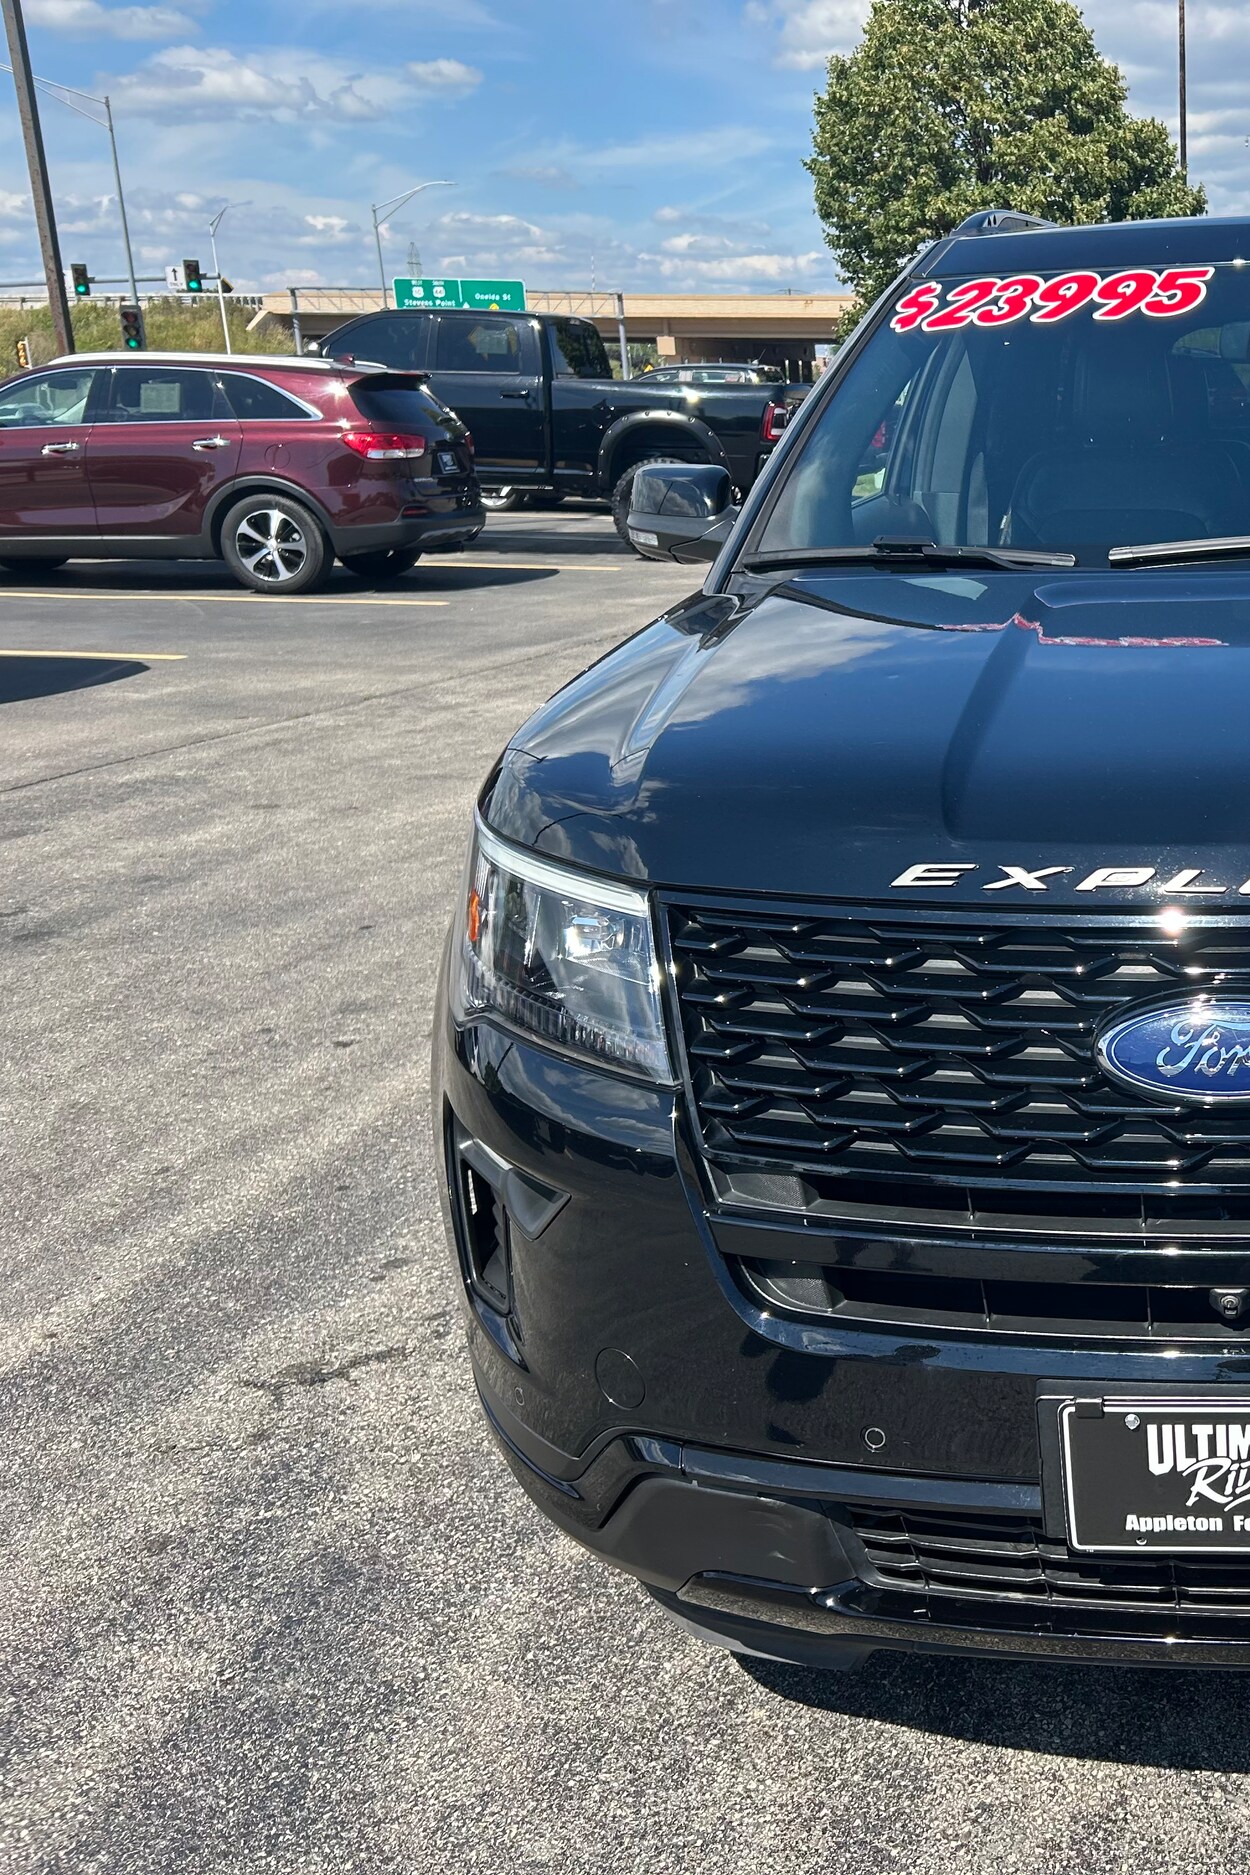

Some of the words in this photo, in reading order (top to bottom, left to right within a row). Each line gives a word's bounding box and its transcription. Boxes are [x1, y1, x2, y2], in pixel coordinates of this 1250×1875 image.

[404, 299, 433, 307] Stevens
[435, 299, 456, 307] Point
[475, 293, 500, 301] Oneida
[503, 293, 511, 301] St
[890, 267, 1215, 333] $23995
[1125, 1514, 1223, 1533] Appleton
